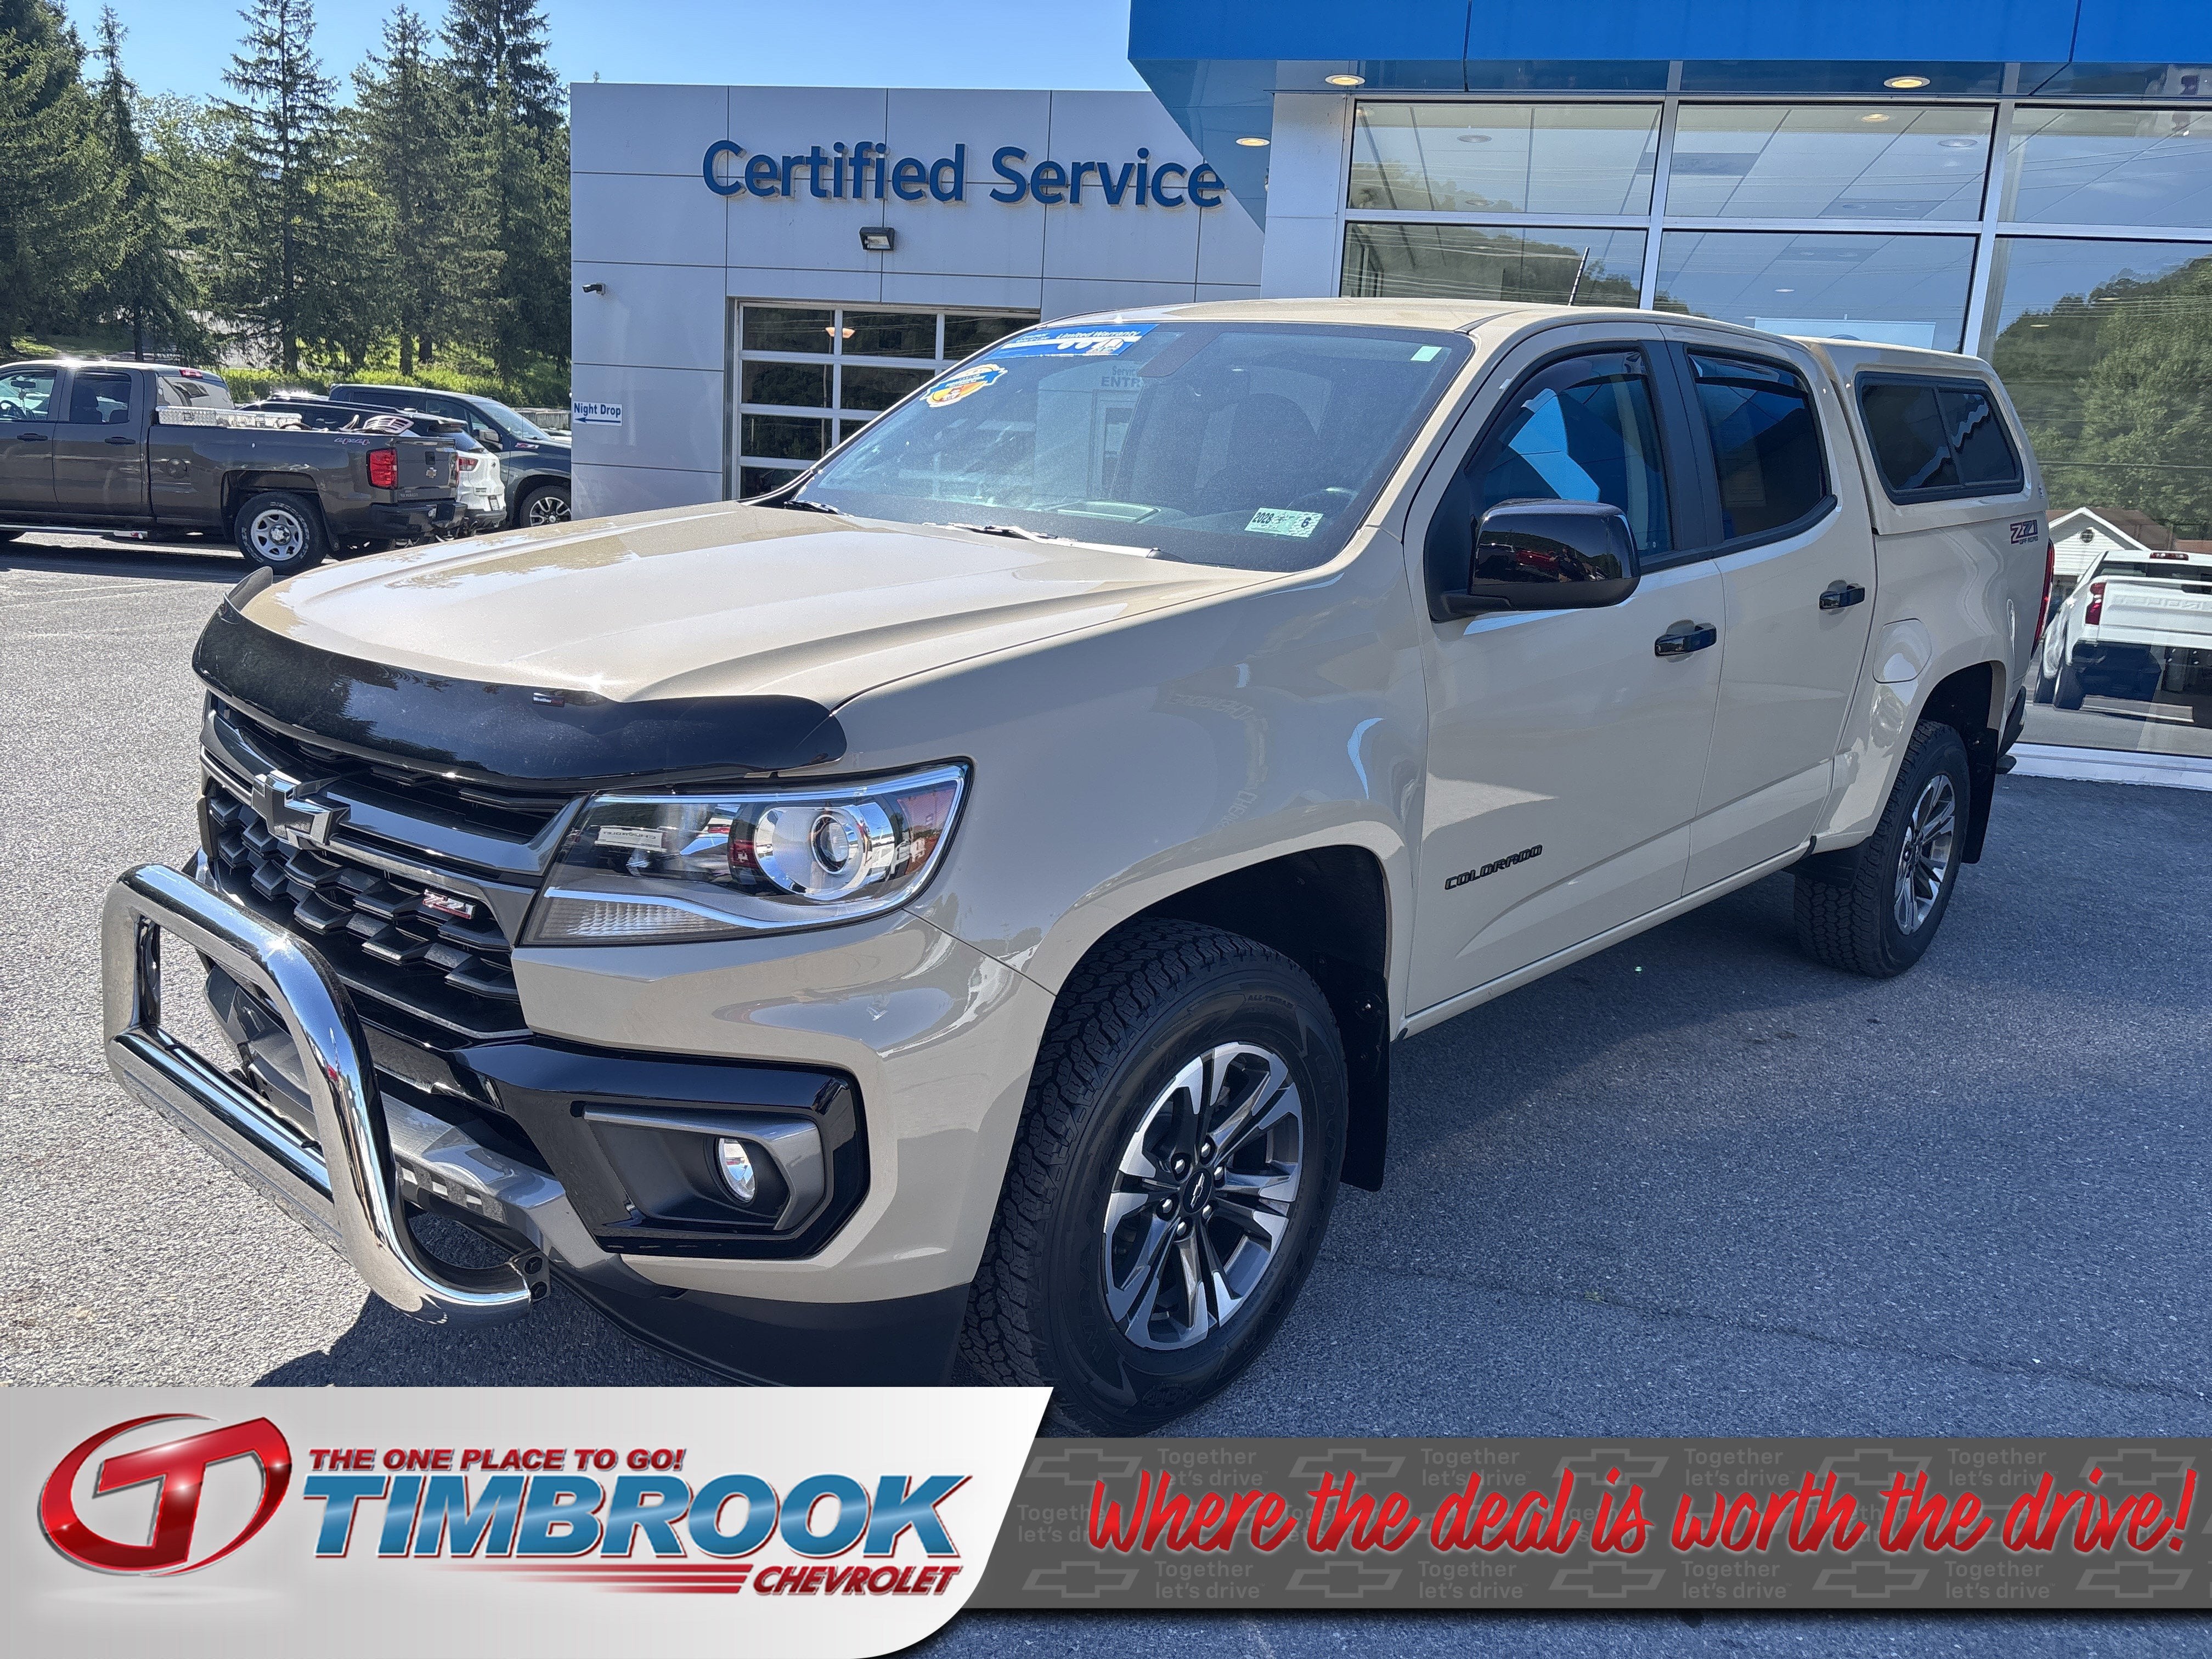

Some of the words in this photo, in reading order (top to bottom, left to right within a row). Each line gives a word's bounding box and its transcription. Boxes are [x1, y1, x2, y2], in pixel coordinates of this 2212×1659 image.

[703, 140, 966, 205] Certified
[989, 146, 1228, 209] Service
[574, 403, 597, 416] Night
[600, 404, 621, 418] Drop
[1301, 517, 1312, 528] 6
[2010, 519, 2038, 544] Z71
[1444, 844, 1543, 890] COLORADO
[422, 889, 476, 919] Z71
